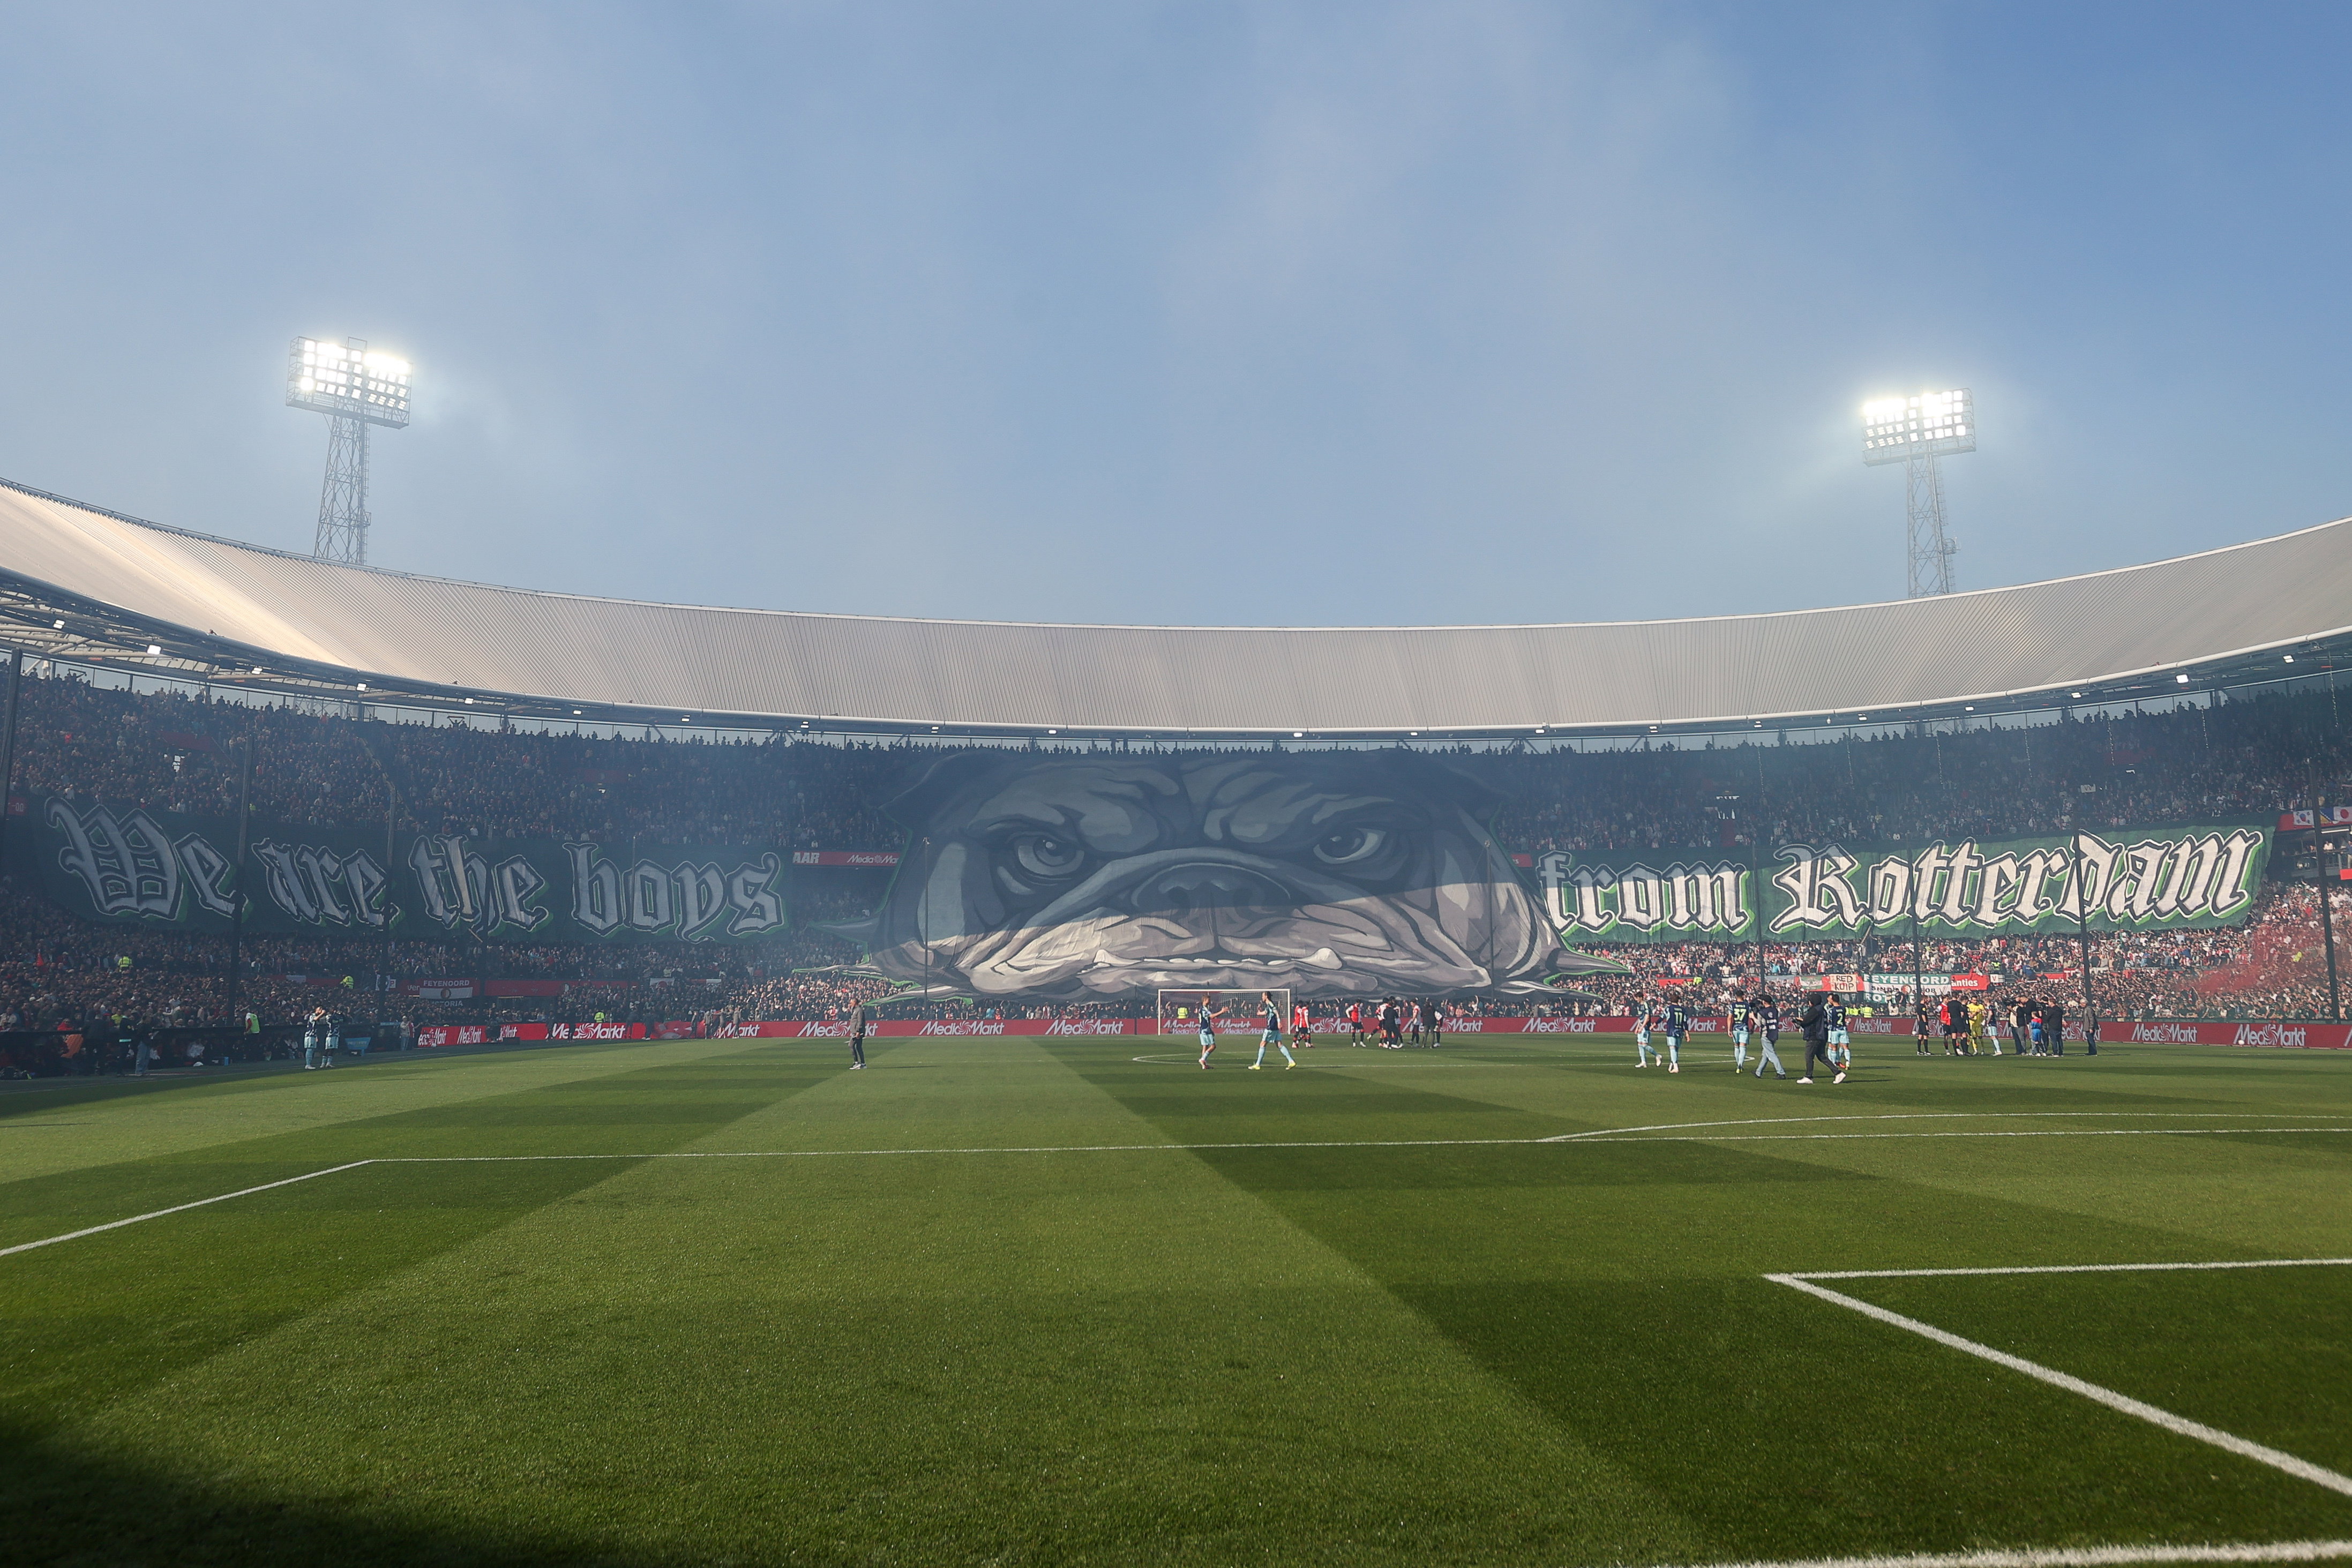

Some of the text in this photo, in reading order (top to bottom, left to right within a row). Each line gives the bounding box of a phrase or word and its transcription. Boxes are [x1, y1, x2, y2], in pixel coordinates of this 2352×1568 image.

[44, 796, 784, 944] We are the boys
[1536, 829, 2264, 935] from Rotterdam
[1863, 974, 1949, 984] FEYENOORD
[1674, 1012, 1682, 1024] 11
[1734, 1008, 1747, 1021] 37
[1837, 1013, 1843, 1025] 2
